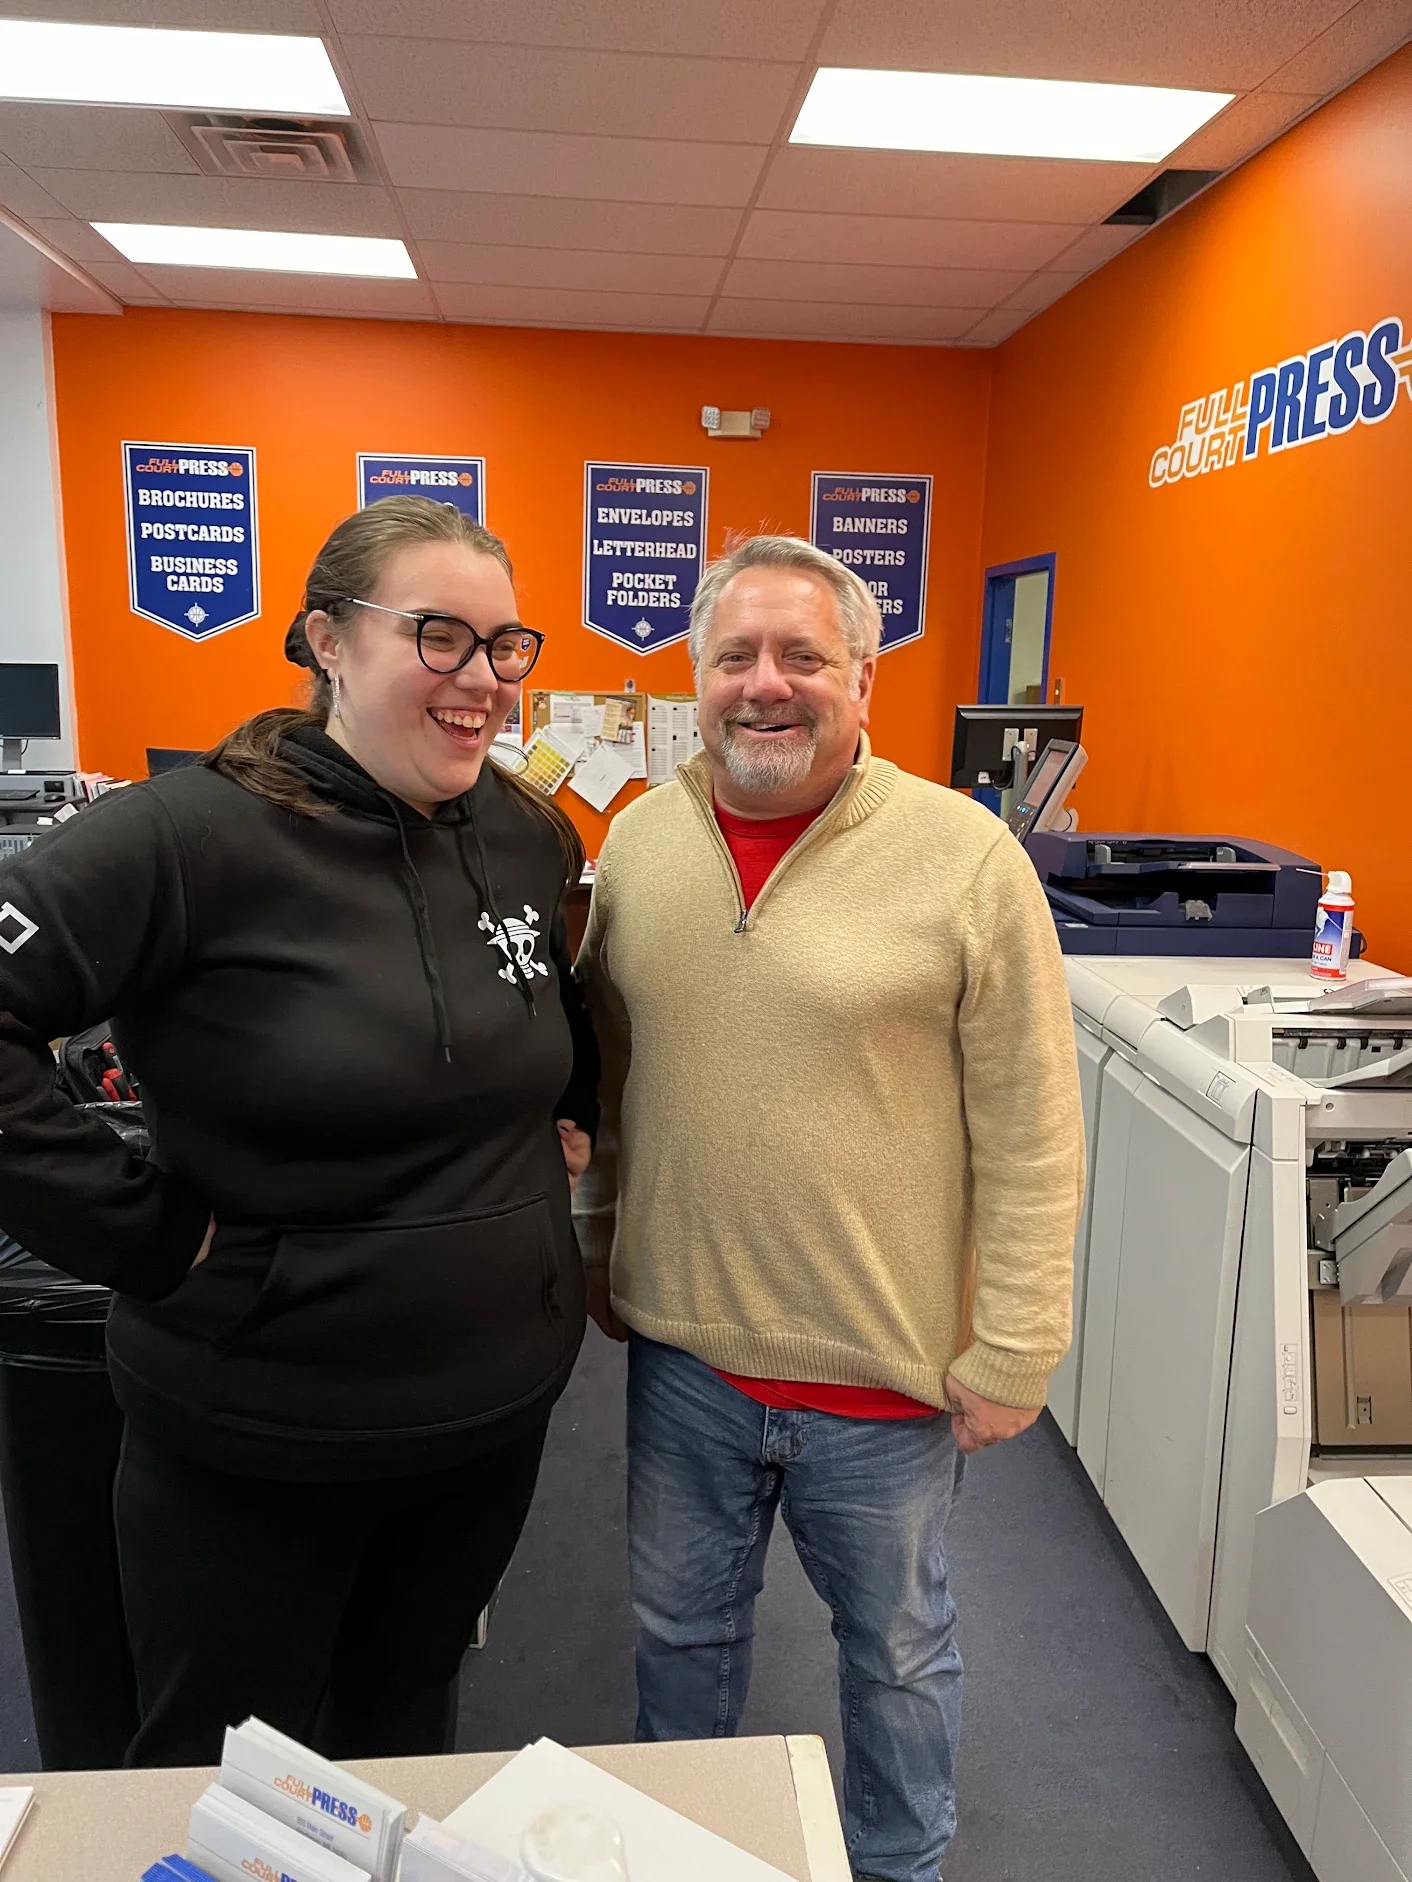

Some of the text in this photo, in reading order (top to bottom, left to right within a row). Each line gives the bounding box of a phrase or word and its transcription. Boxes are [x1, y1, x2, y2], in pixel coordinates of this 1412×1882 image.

[1149, 316, 1403, 488] COURT PRESS
[1177, 382, 1248, 442] FULL
[136, 459, 229, 477] COURT PRESS
[149, 458, 179, 466] FULL
[369, 470, 459, 487] COURT PRESS
[381, 469, 411, 477] FULL
[608, 477, 637, 485] FULL
[596, 478, 683, 495] COURT PRESS
[822, 487, 907, 504] COURT PRESS
[834, 487, 862, 495] FULL
[138, 489, 245, 510] BROCHURES
[597, 507, 694, 527] ENVELOPES
[832, 516, 908, 534] BANNERS
[140, 523, 245, 543] POSTCARDS
[592, 539, 697, 559] LETTERHEAD
[832, 548, 905, 566] POSTERS
[150, 556, 239, 575] BUSINESS
[166, 575, 224, 593] CARDS
[612, 572, 677, 590] POCKET
[867, 581, 888, 597] OR
[606, 589, 681, 608] FOLDERS
[876, 599, 903, 615] ERS
[286, 1774, 312, 1793] FULL
[273, 1777, 358, 1827] COURT PRESS
